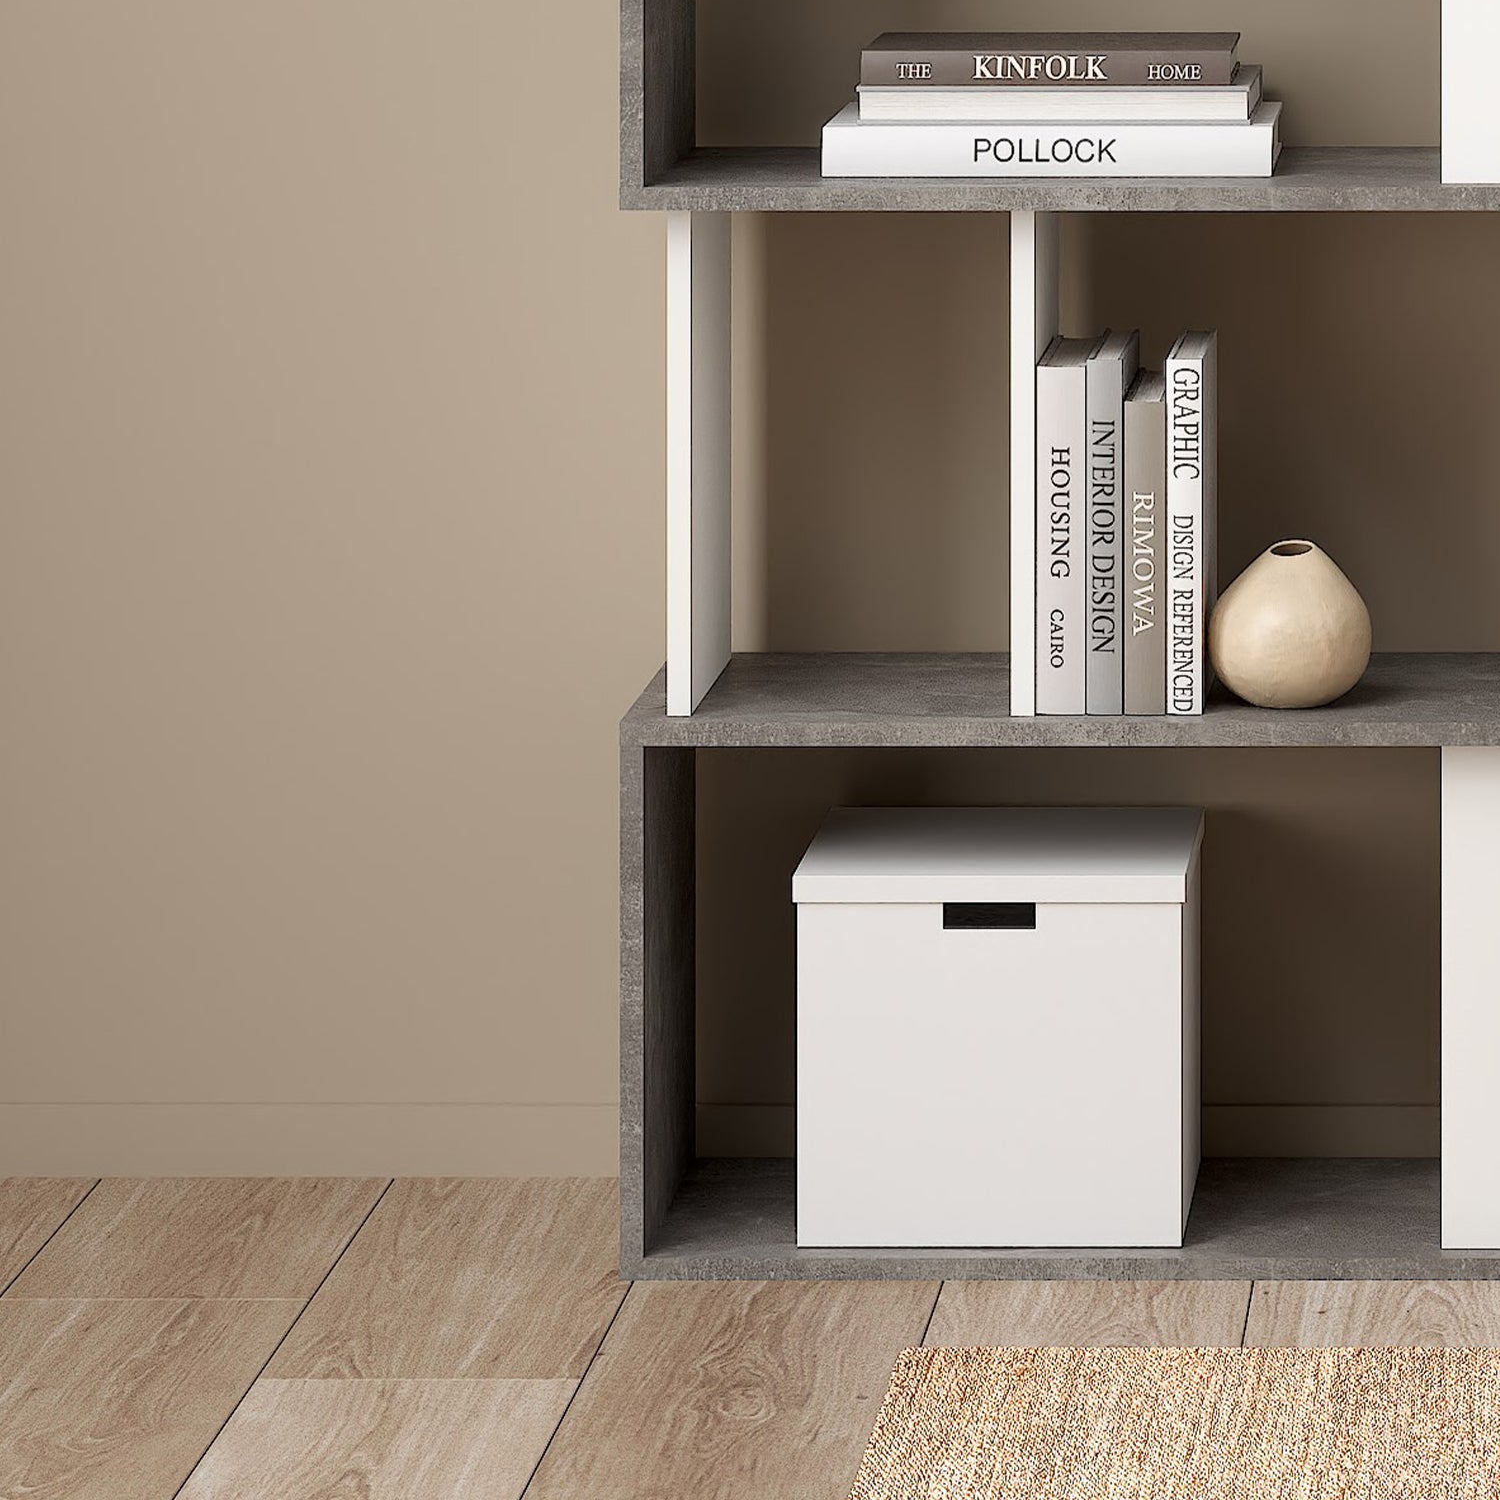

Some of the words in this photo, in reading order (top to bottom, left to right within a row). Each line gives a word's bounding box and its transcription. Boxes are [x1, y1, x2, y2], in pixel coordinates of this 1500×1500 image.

[896, 62, 932, 80] THE
[972, 54, 1108, 81] KINFOLK
[1147, 63, 1202, 81] HOME
[973, 137, 1117, 163] POLLOCK
[1173, 367, 1200, 479] GRAPHIC
[1051, 446, 1070, 579] HOUSING
[1092, 420, 1115, 546] INTERIOR
[1133, 491, 1155, 636] RIMOWA
[1173, 514, 1194, 580] DISIGN
[1050, 608, 1065, 669] CAIRO
[1092, 553, 1115, 653] DESIGN
[1173, 589, 1194, 713] REFERENCED
